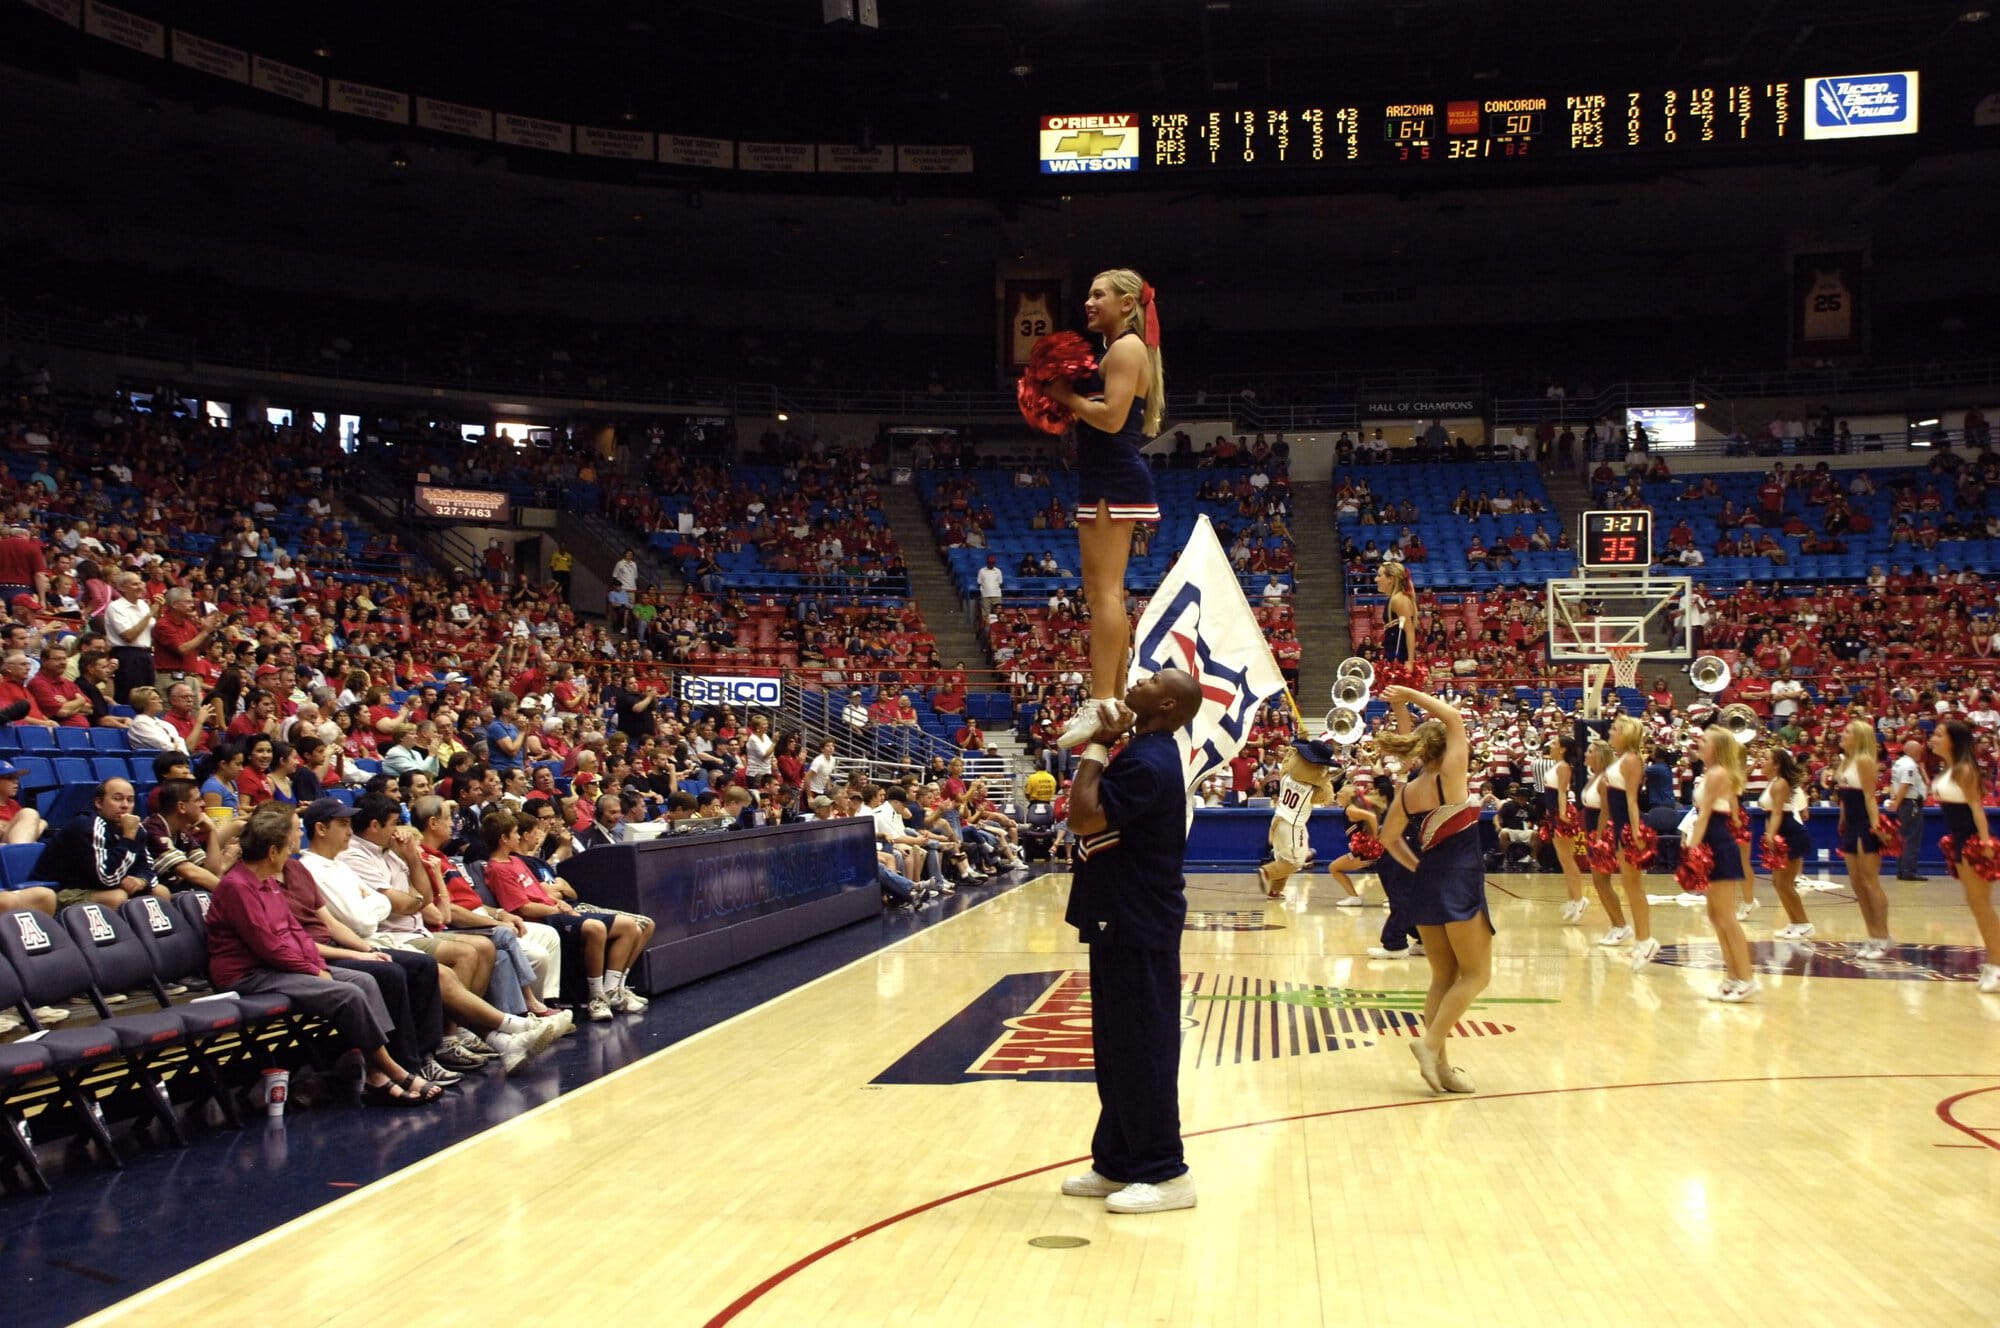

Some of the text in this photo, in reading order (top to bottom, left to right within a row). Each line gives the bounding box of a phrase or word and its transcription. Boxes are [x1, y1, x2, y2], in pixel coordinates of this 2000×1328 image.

[1567, 83, 1789, 109] PLYR 7 9 10 12 15
[1837, 82, 1890, 95] Tucson
[1485, 98, 1547, 113] CONCORDIA
[1843, 92, 1899, 106] Electric
[1152, 108, 1358, 127] PLYR 5 13 34 42 43
[1386, 104, 1434, 117] ARIZONA
[1448, 110, 1478, 118] WELLS
[1573, 108, 1601, 122] PTS
[1729, 99, 1751, 113] 13
[1776, 97, 1789, 110] 6
[1847, 105, 1899, 118] Power
[1048, 115, 1130, 129] O'RIELLY
[1158, 127, 1184, 139] PTS
[1201, 125, 1221, 138] 13
[1244, 124, 1255, 137] 9
[1312, 122, 1323, 134] 6
[1338, 121, 1358, 134] 12
[1400, 120, 1425, 139] 64
[1506, 114, 1532, 134] 50
[1572, 122, 1603, 135] RBS
[1738, 112, 1751, 126] 7
[1776, 110, 1789, 124] 3
[1156, 140, 1186, 152] RBS
[1209, 138, 1221, 150] 5
[1278, 136, 1289, 148] 3
[1312, 135, 1323, 147] 3
[1347, 134, 1358, 146] 4
[1572, 135, 1604, 148] FLS
[1627, 132, 1640, 146] 3
[1701, 128, 1714, 141] 3
[1347, 146, 1358, 159] 3
[1447, 138, 1491, 159] 3:21
[1049, 158, 1131, 172] WATSON
[1814, 294, 1840, 312] 25
[1020, 320, 1046, 337] 32
[1369, 400, 1474, 412] HALL OF CHAMPIONS
[436, 506, 491, 518] 327-7463
[1602, 516, 1643, 532] 3:21
[1600, 537, 1636, 562] 35
[1466, 596, 1476, 604] 21
[1832, 589, 1844, 597] 22
[766, 598, 775, 607] 19
[1138, 600, 1149, 608] 20
[853, 672, 863, 681] 19
[684, 681, 777, 702] GEICO
[1282, 788, 1300, 809] 00
[142, 897, 173, 932] A
[14, 912, 51, 951] A
[82, 905, 116, 942] A
